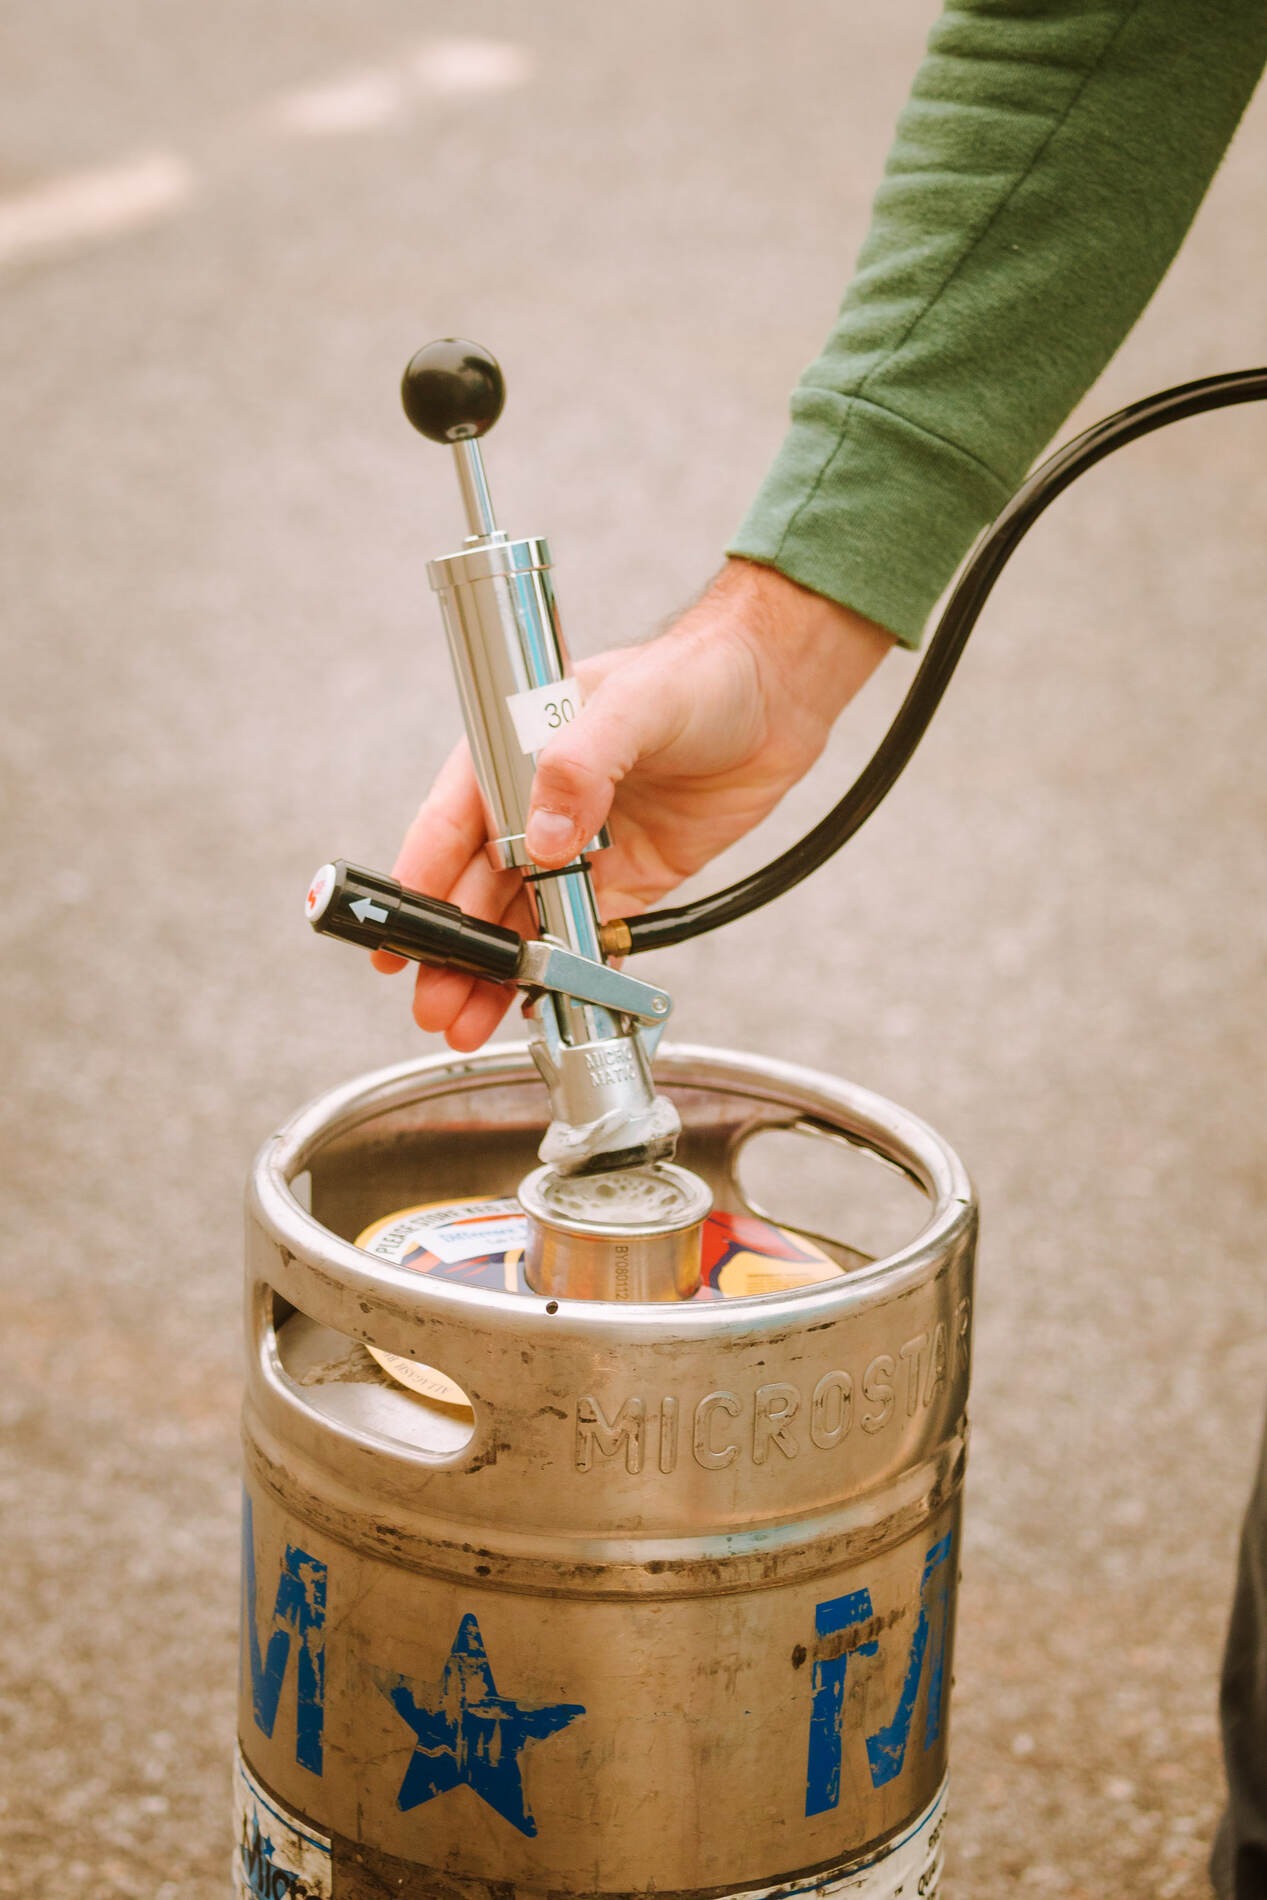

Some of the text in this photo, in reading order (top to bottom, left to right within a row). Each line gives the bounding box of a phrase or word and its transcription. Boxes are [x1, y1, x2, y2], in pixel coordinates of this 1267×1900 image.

[543, 698, 575, 729] 30
[584, 1046, 633, 1071] MICRO
[589, 1065, 638, 1088] MATIC
[375, 1223, 421, 1255] PLEASE
[575, 1297, 969, 1475] MICROSTAR
